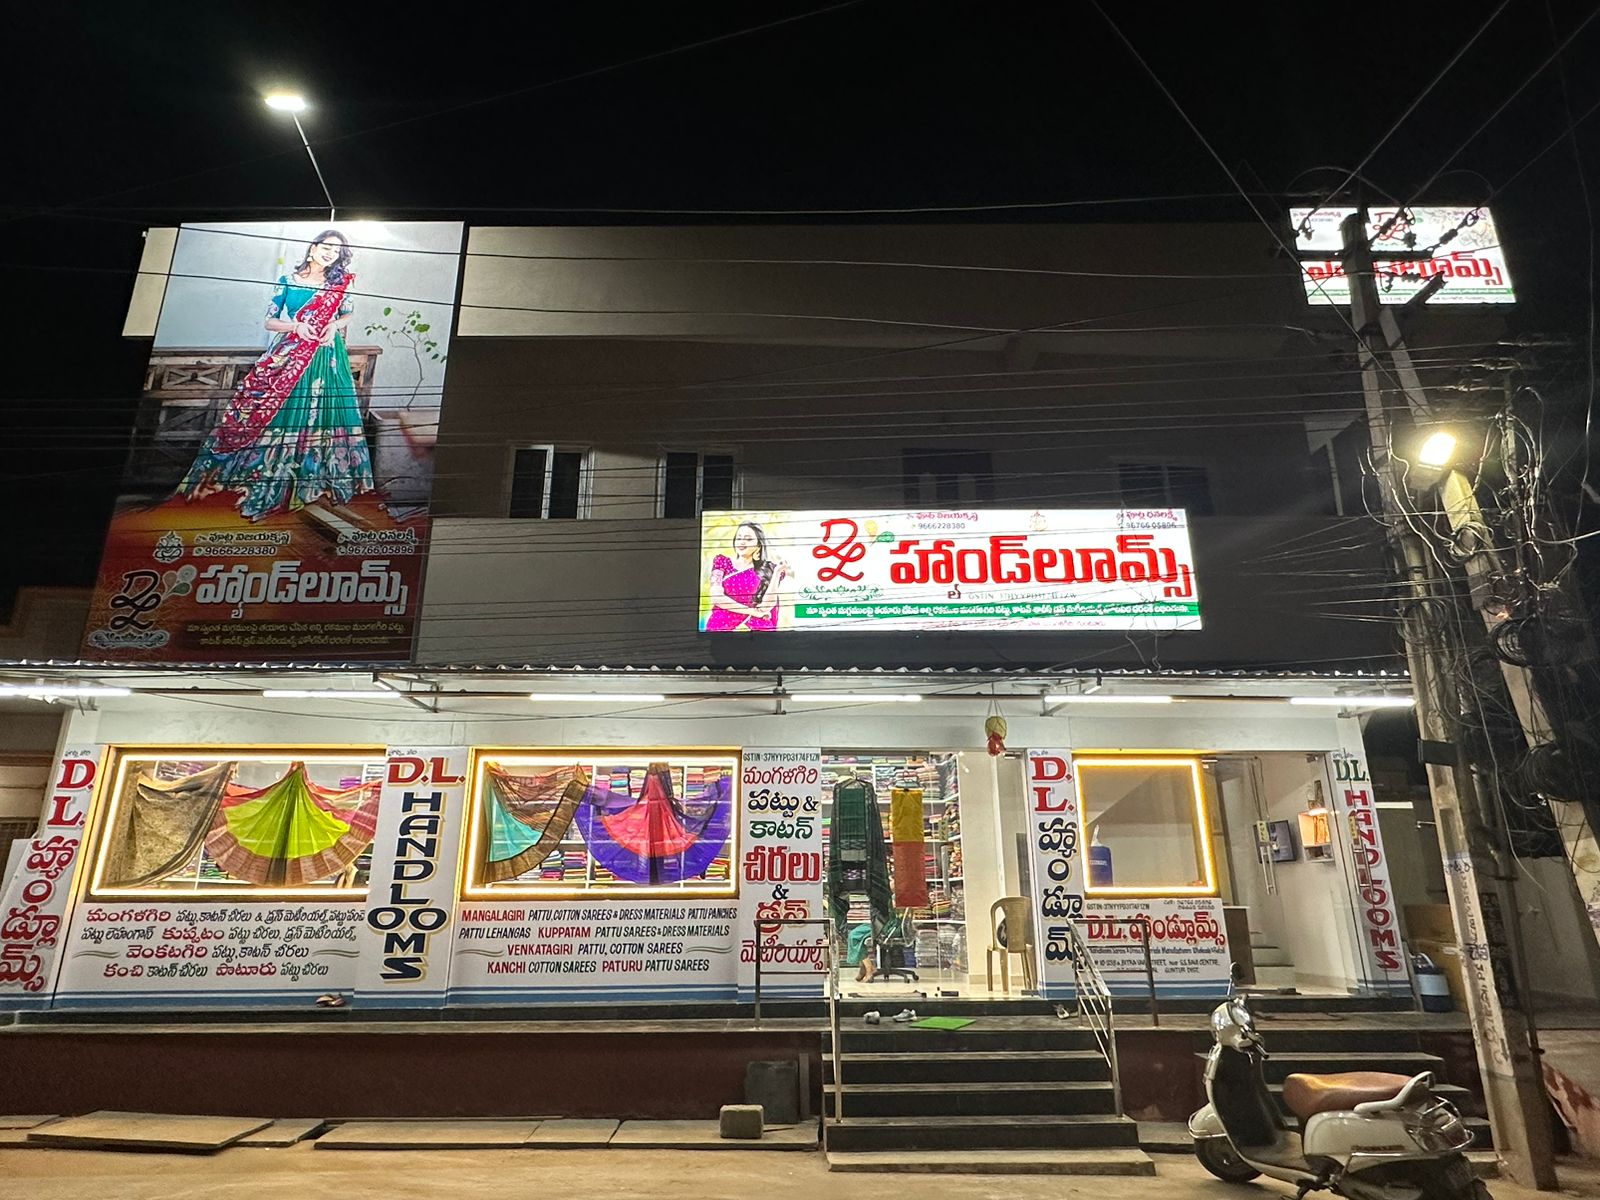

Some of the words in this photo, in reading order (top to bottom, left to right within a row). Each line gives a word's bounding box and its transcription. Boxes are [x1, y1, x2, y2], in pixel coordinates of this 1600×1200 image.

[918, 522, 966, 530] 9666228380
[205, 546, 276, 555] 9666228380
[348, 546, 380, 554] 96766
[382, 546, 413, 554] 05896
[387, 757, 467, 784] D.L.
[743, 764, 818, 785] మంగళగిరి
[1332, 758, 1370, 782] D.L.
[748, 788, 799, 818] పట్టు
[802, 795, 820, 812] &
[749, 817, 815, 840] కాటన్
[743, 845, 821, 883] చీరలు
[368, 791, 447, 981] HANDLOOMS
[772, 884, 789, 900] &
[86, 908, 171, 922] మంగళగిరి
[255, 911, 263, 922] &
[461, 909, 525, 922] MANGALAGIRI
[582, 908, 612, 921] SAREES
[612, 910, 618, 919] &
[618, 908, 643, 921] DRESS
[643, 907, 685, 921] MATERIALS
[687, 907, 708, 920] PATTU
[708, 906, 738, 920] PANCHES
[81, 926, 105, 944] పట్టు
[161, 926, 225, 943] కుప్పటం
[229, 926, 251, 944] పట్టు
[458, 927, 486, 940] PATTU
[486, 926, 531, 939] LEHANGAS
[537, 926, 591, 939] KUPPATAM
[595, 925, 623, 938] PATTU
[623, 925, 656, 938] SAREES
[662, 924, 687, 937] DRESS
[687, 924, 730, 937] MATERIALS
[1086, 915, 1127, 939] D.L.
[126, 943, 208, 959] వెంకటగిరి
[274, 943, 309, 959] చీరలు
[507, 943, 573, 956] VENKATAGIRI
[578, 942, 608, 956] PATTU,
[610, 942, 644, 955] COTTON
[647, 941, 683, 954] SAREES
[103, 963, 144, 978] కంచి
[146, 963, 179, 978] కాటన్
[179, 963, 208, 978] చీరలు
[280, 961, 301, 982] పట్టు
[302, 962, 329, 977] చీరలు
[487, 960, 526, 974] KANCHI
[528, 960, 561, 974] COTTON
[562, 960, 597, 973] SAREES
[602, 959, 643, 973] PATURU
[645, 958, 674, 972] PATTU
[674, 958, 710, 972] SAREES
